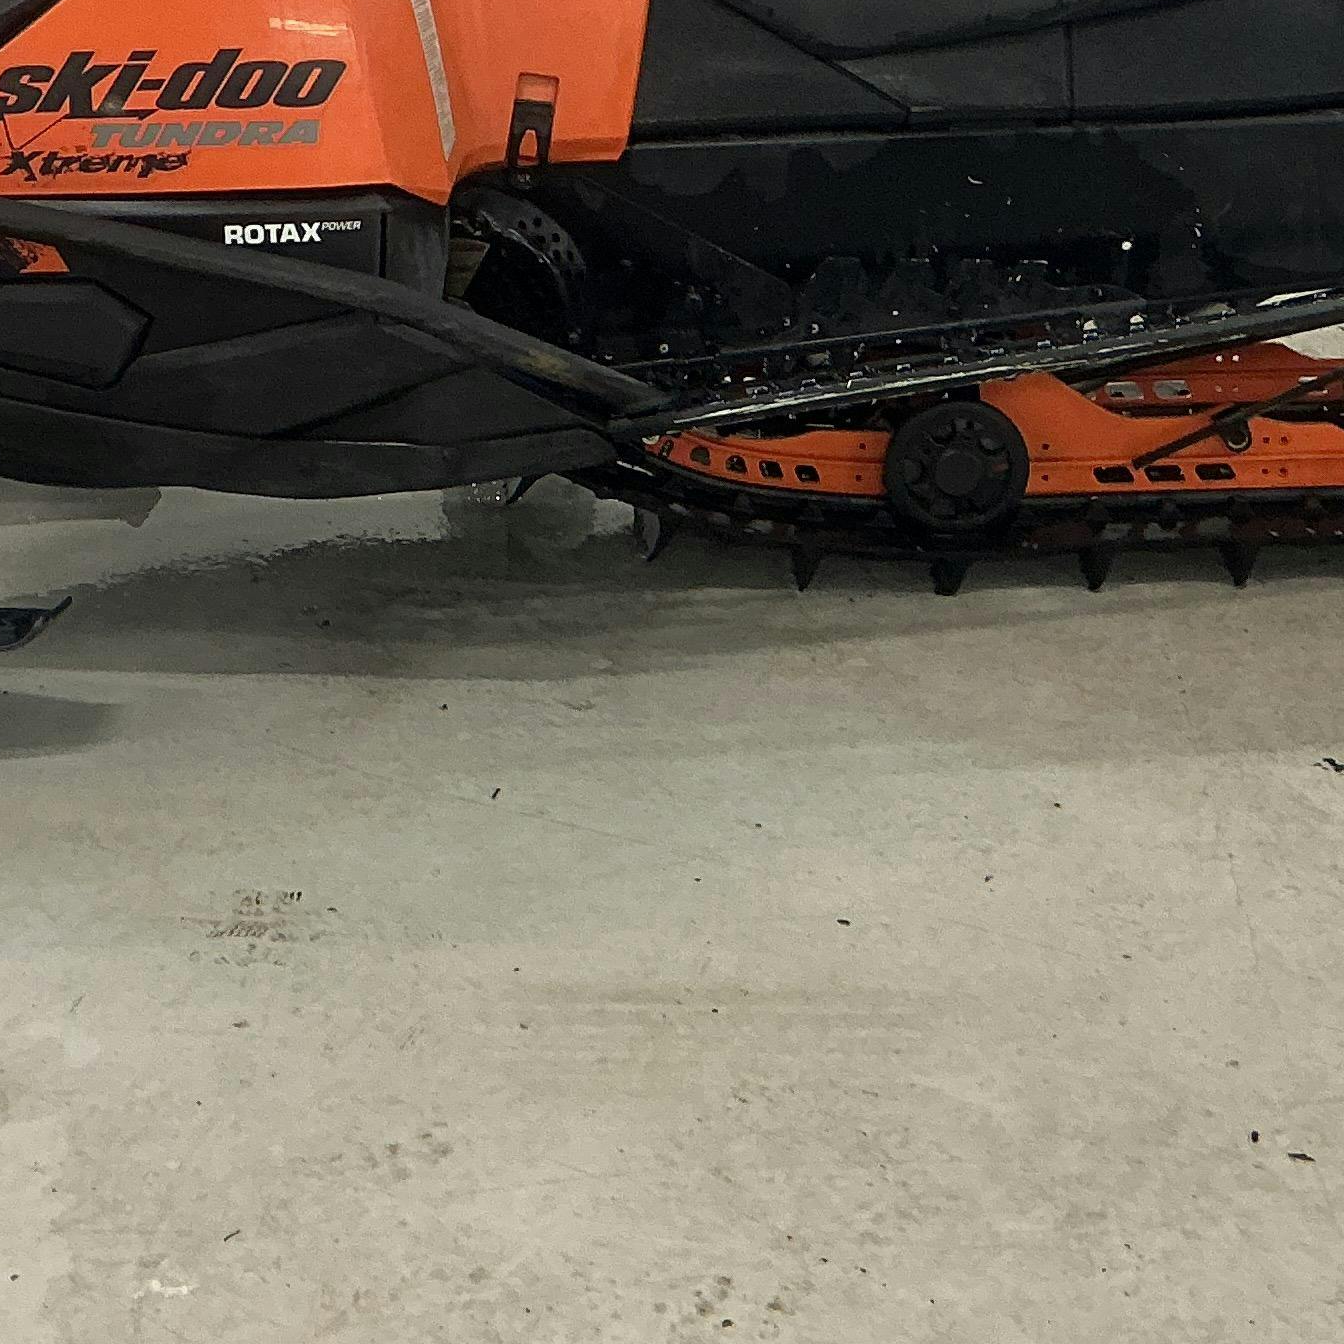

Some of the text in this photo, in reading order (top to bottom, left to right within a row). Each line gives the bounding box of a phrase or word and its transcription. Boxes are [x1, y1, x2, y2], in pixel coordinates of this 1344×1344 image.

[90, 119, 320, 149] TUNDRA
[224, 220, 362, 246] ROTAX POWER
